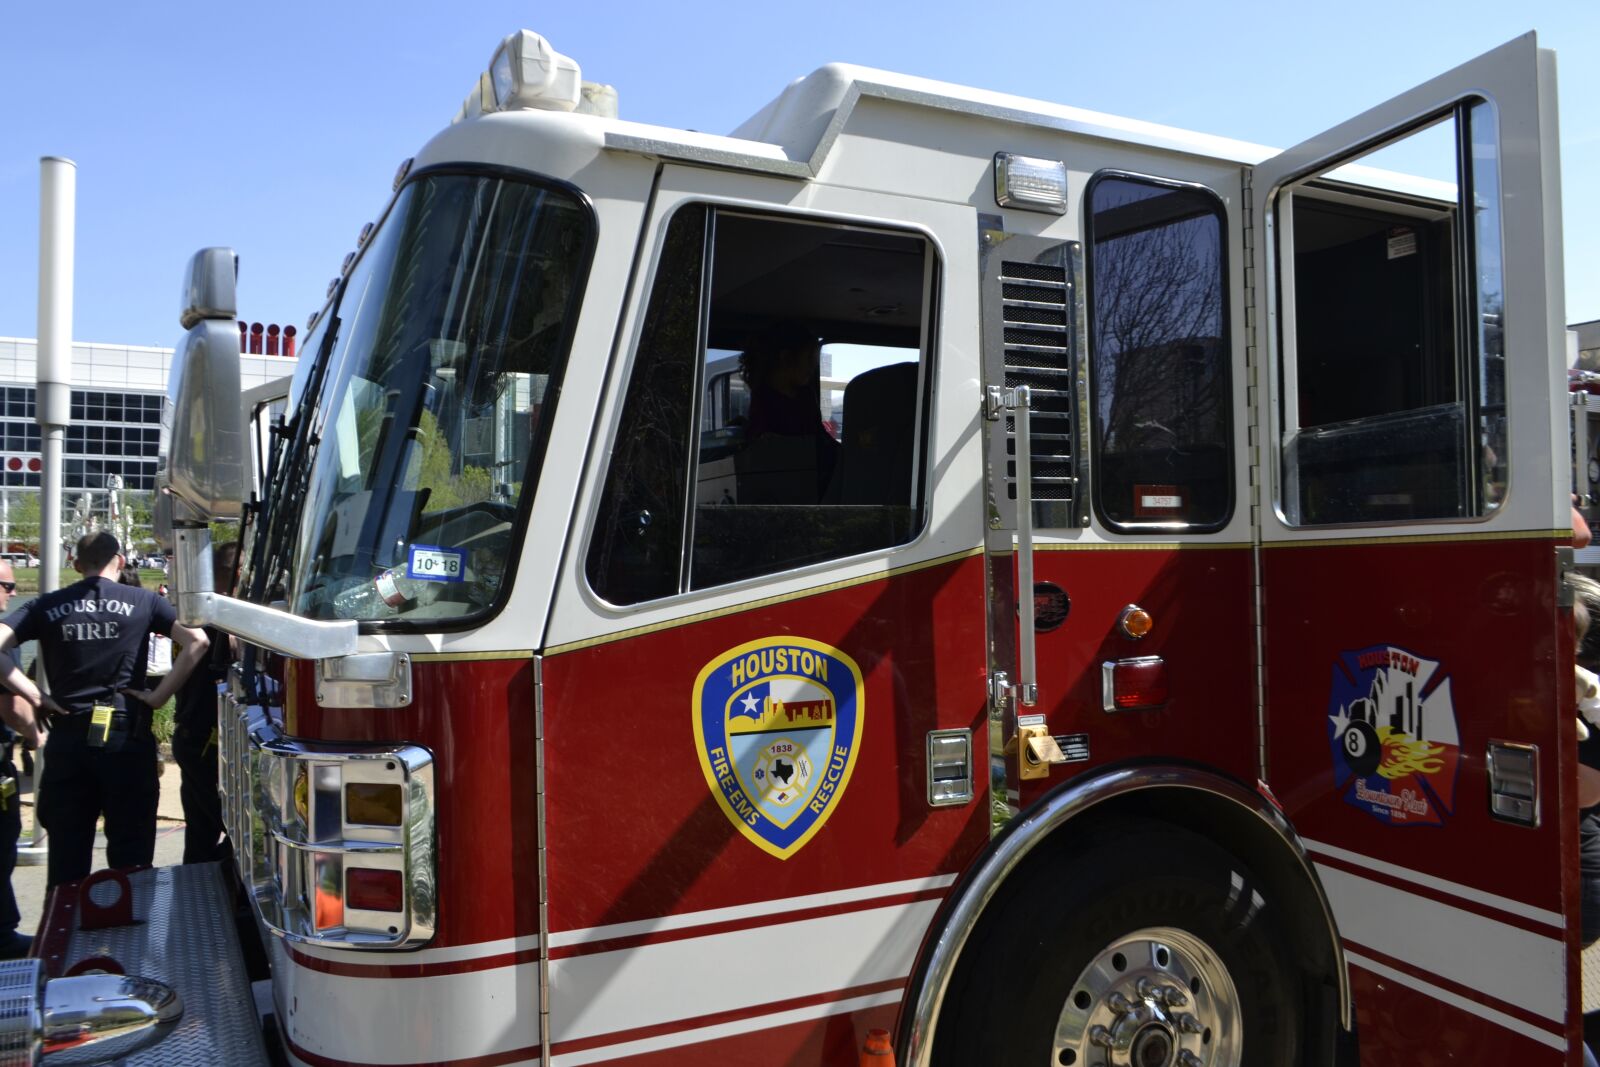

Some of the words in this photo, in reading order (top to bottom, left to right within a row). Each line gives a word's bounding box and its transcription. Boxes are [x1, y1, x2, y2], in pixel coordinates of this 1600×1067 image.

[417, 558, 433, 571] 10
[441, 560, 459, 572] 18
[48, 599, 135, 622] HOUSTON
[61, 622, 119, 641] FIRE
[731, 648, 828, 688] HOUSTON
[1358, 651, 1419, 677] HOUSTON
[770, 744, 793, 754] 1838
[1349, 732, 1359, 752] 8
[710, 747, 761, 826] FIRE-EMS
[809, 745, 848, 814] RESCUE
